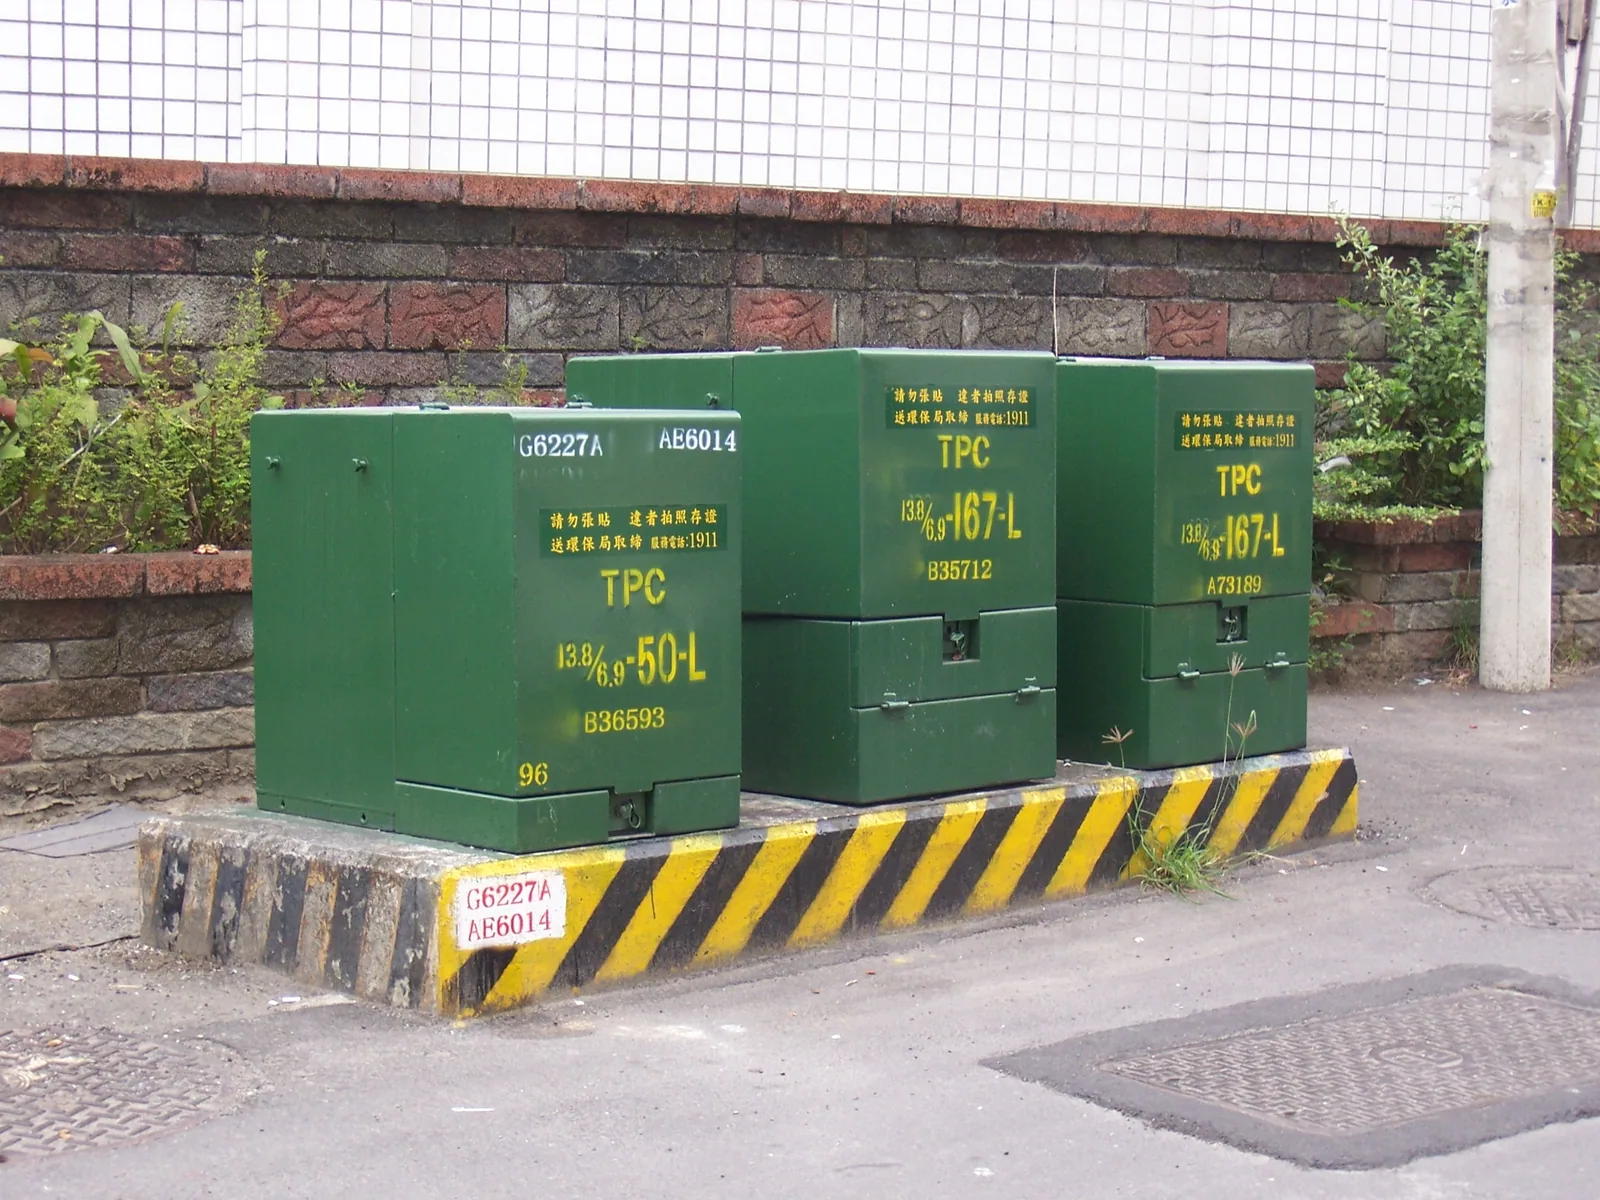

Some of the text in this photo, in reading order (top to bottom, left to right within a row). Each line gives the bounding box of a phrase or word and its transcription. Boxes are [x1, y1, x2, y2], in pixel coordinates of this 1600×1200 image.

[894, 388, 943, 404] 請勿張貼
[518, 427, 737, 457] G6227A AE6014
[937, 434, 991, 469] TPC
[1216, 463, 1262, 497] TPC
[549, 511, 612, 530] 請勿張貼
[550, 534, 643, 554] 送環保局取締
[928, 559, 993, 581] B35712
[600, 567, 666, 608] TPC
[1207, 575, 1262, 595] A73189
[584, 706, 665, 734] B36593
[518, 762, 549, 787] 96
[466, 878, 552, 911] G6227A
[467, 909, 552, 942] AE6014
